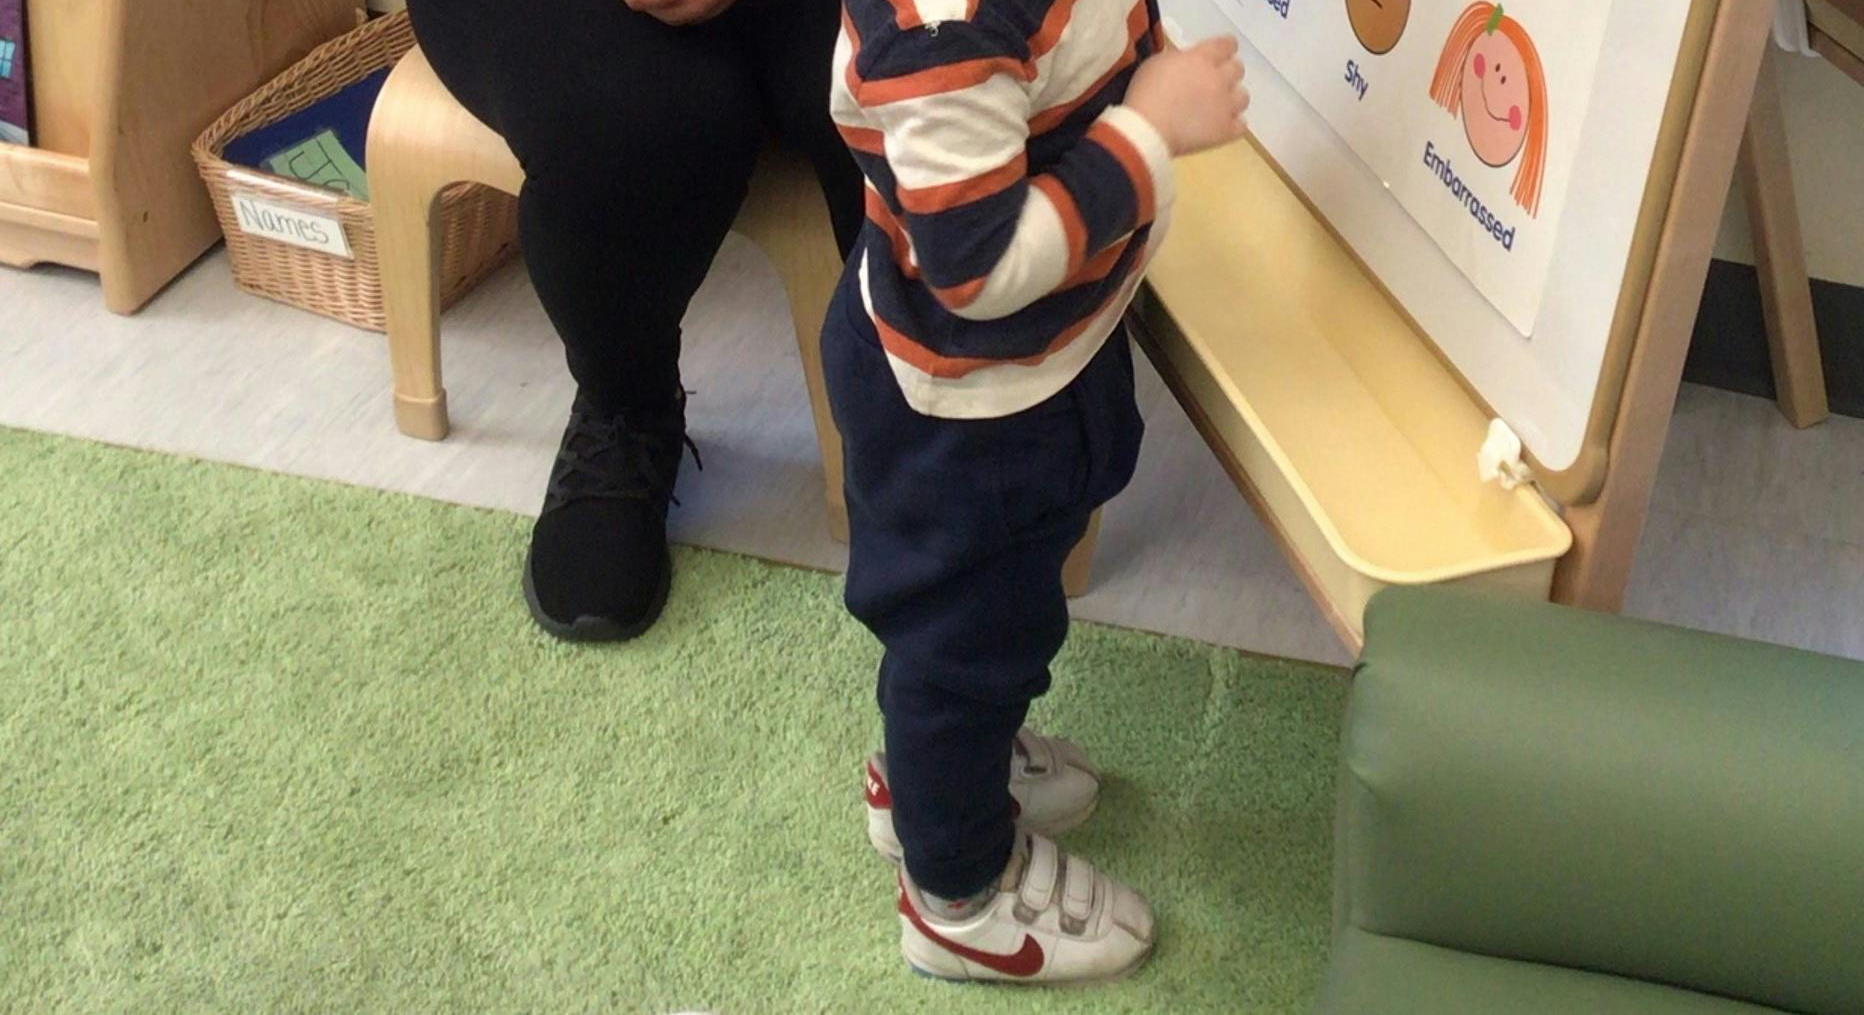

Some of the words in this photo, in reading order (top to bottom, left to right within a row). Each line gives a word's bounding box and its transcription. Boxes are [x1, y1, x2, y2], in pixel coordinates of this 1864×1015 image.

[1344, 59, 1370, 102] Shy
[1423, 140, 1517, 252] Embarrassed
[240, 198, 330, 244] Names
